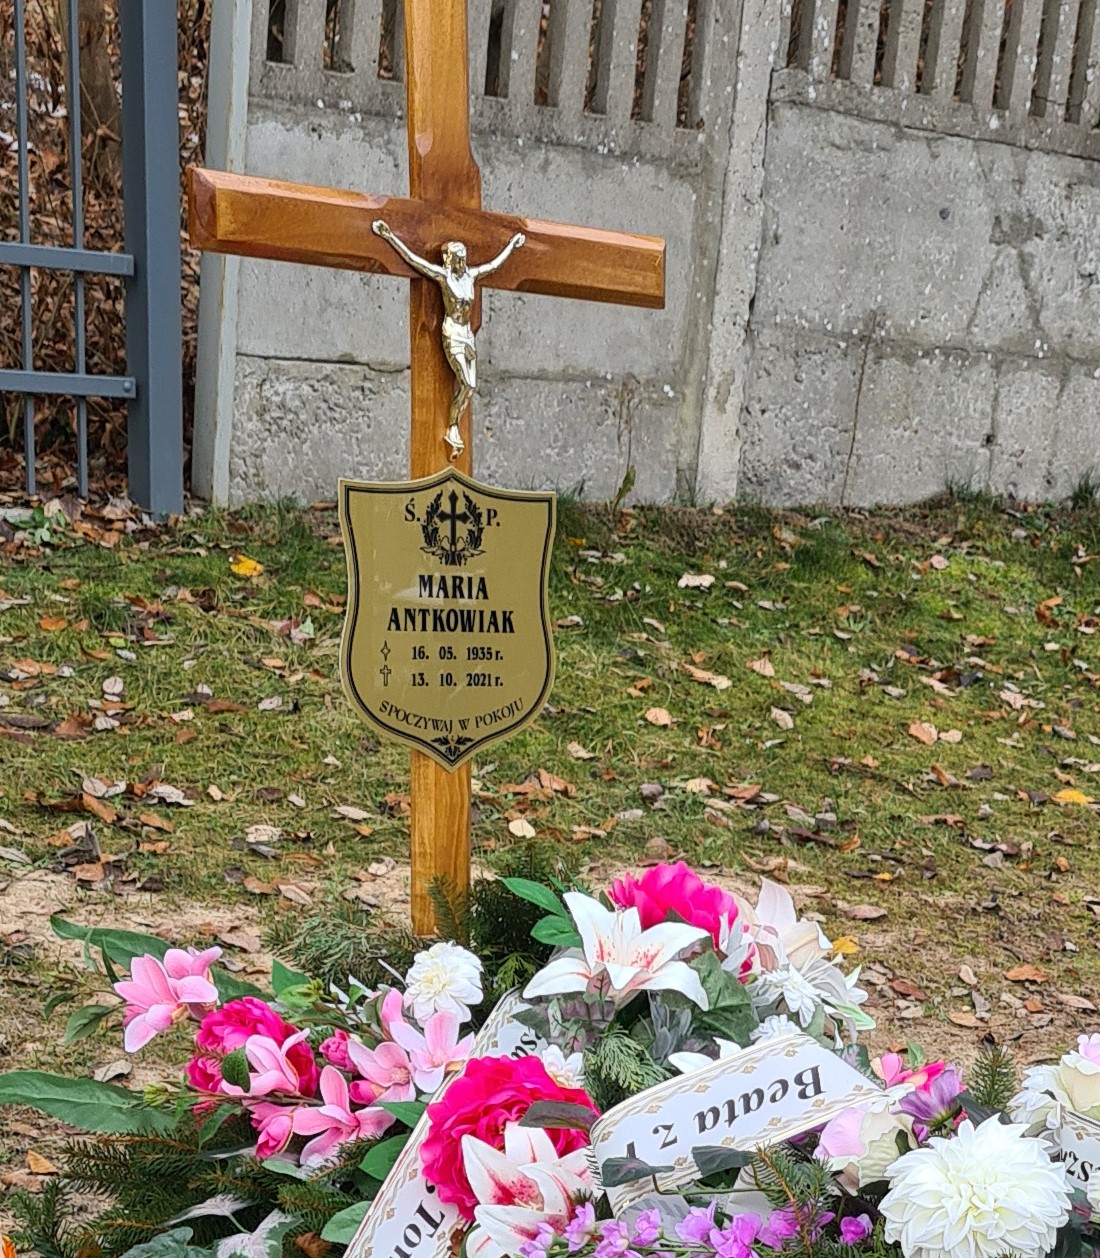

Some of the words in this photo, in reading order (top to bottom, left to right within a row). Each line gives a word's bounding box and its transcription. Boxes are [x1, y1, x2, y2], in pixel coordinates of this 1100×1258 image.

[404, 497, 421, 522] Ś.
[486, 508, 501, 527] P.
[418, 574, 489, 600] MARIA
[387, 607, 515, 633] ANTKOWIAK
[411, 645, 429, 660] 16.
[438, 645, 457, 660] 05.
[411, 672, 429, 687] 13.
[439, 672, 457, 687] 10.
[378, 700, 453, 734] SPOCZYWAJ
[459, 717, 471, 731] W
[474, 697, 525, 728] POKOJU
[693, 1064, 827, 1134] Beata
[651, 1122, 678, 1150] z
